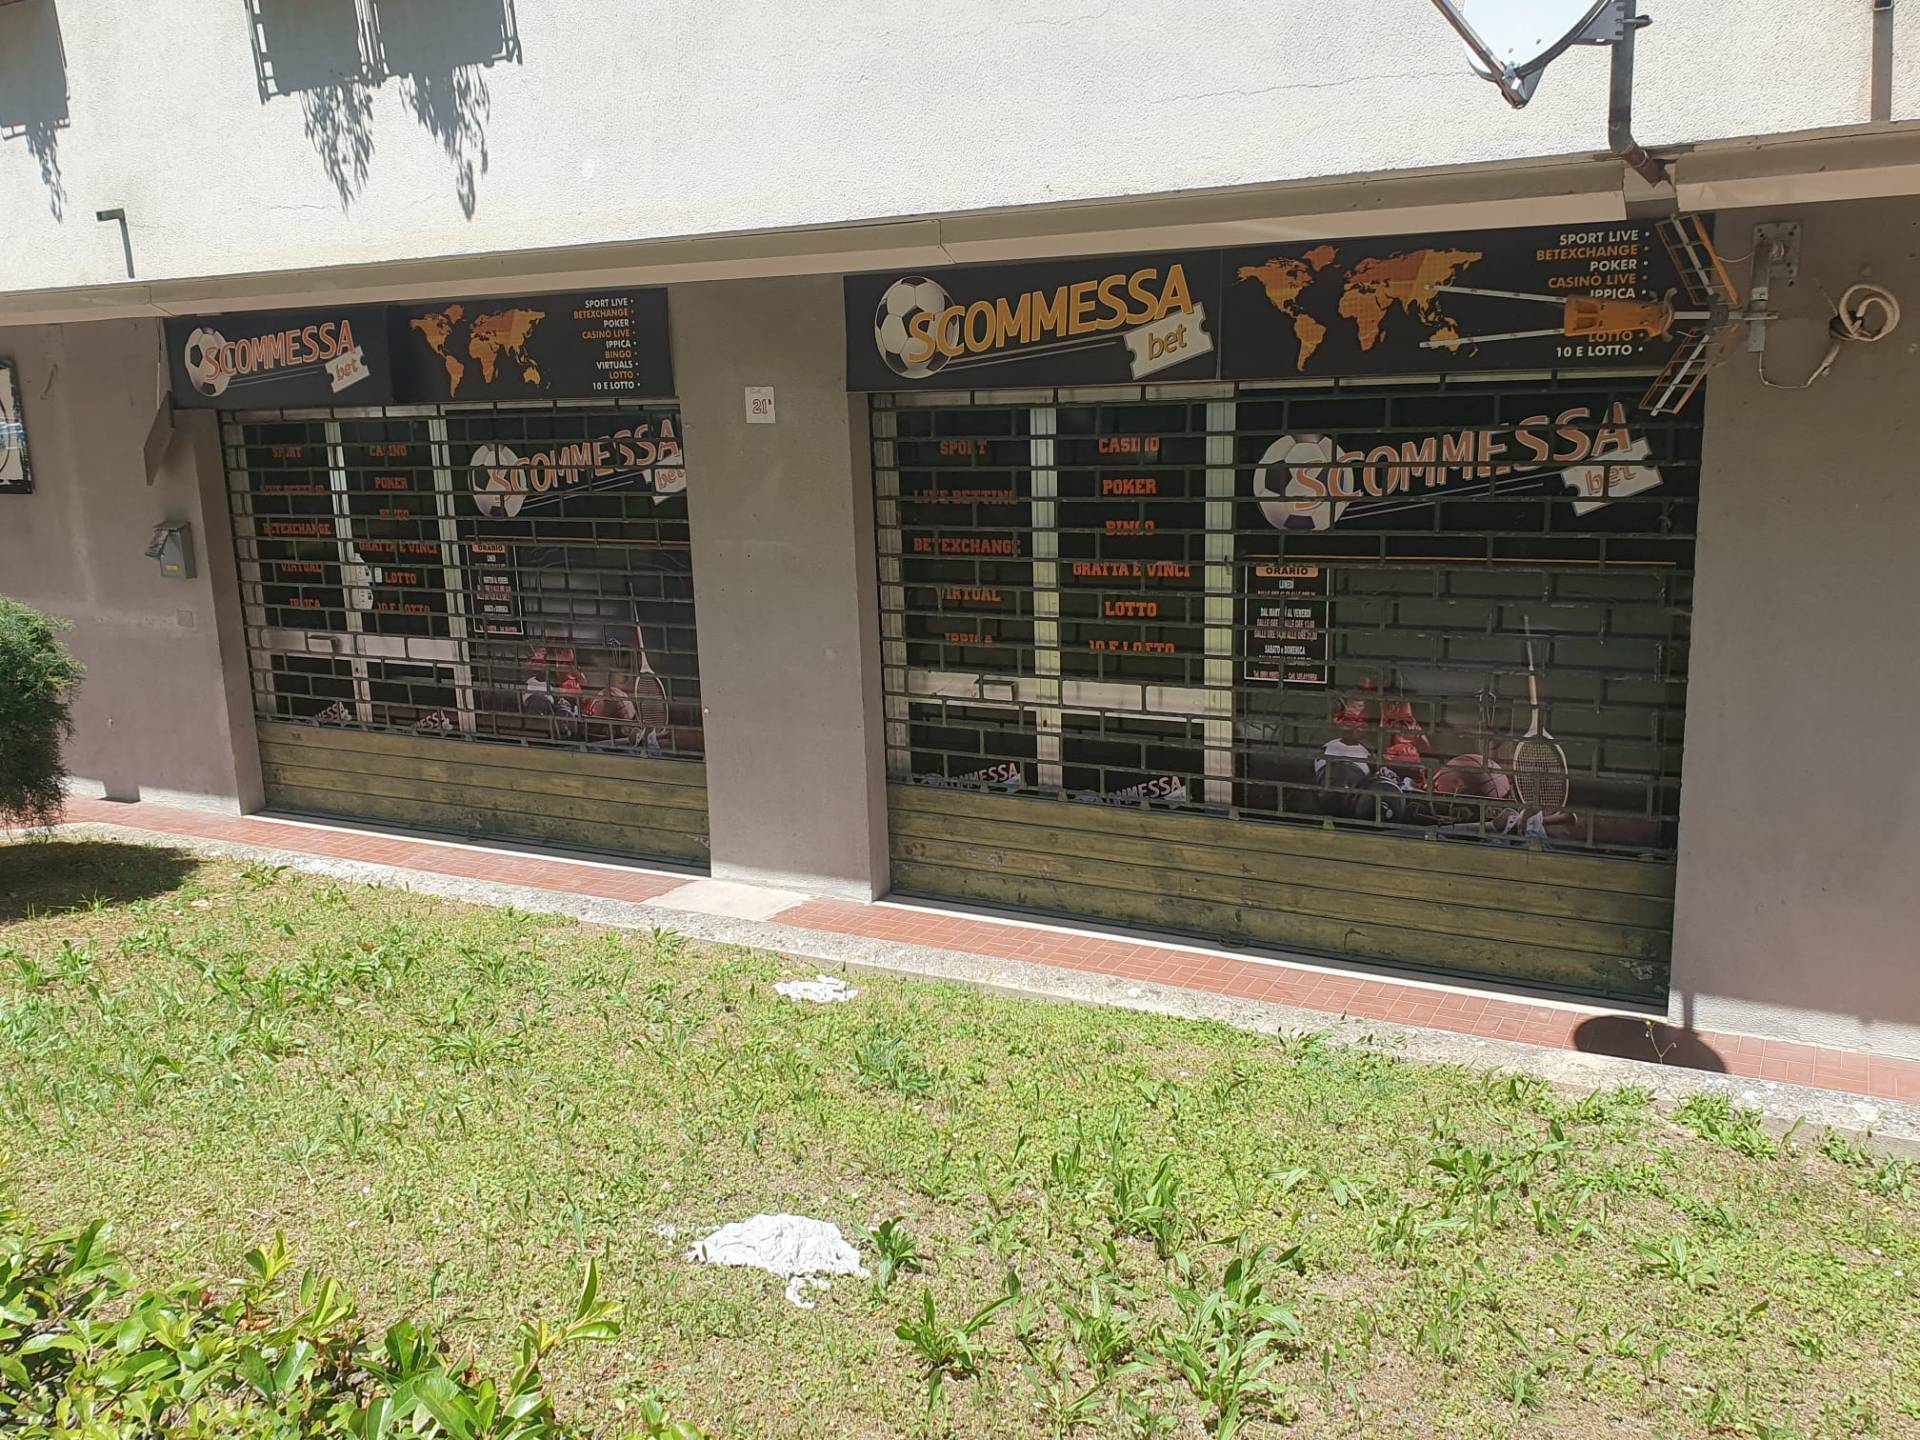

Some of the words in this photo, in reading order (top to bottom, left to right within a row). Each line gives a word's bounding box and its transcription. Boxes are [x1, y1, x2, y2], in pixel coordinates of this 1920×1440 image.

[1560, 232, 1604, 246] SPORT
[1608, 230, 1639, 242] LIVE
[1536, 244, 1639, 261] BETEXCHANGE
[1590, 259, 1637, 272] POKER
[1606, 273, 1637, 286] LIVE
[585, 299, 609, 308] SPORT
[611, 298, 628, 306] LIVE
[573, 308, 629, 319] BETEXCHANGE
[908, 263, 1194, 363] SCOMMESSA
[1148, 323, 1188, 361] bet
[603, 319, 630, 328] POKER
[613, 329, 630, 338] LIVE
[1588, 331, 1633, 343] LOTTO
[204, 319, 356, 381] SCOMMESSA
[335, 357, 359, 381] bet
[606, 340, 631, 348] IPPICA
[1556, 346, 1572, 357] 10
[1576, 346, 1583, 357] E
[1588, 344, 1632, 357] LOTTO
[605, 350, 632, 359] BINGO
[596, 360, 633, 370] VIRTUALS
[609, 370, 634, 379] LOTTO
[592, 382, 602, 390] 10
[603, 382, 609, 390] E
[610, 381, 635, 390] LOTTO
[1295, 401, 1632, 510] SCOMMESSA
[1103, 479, 1157, 495] POKER
[1147, 562, 1191, 577] VINCI
[1265, 567, 1309, 576] ORARIO
[385, 571, 417, 584] LOTTO
[1105, 601, 1157, 617] LOTTO
